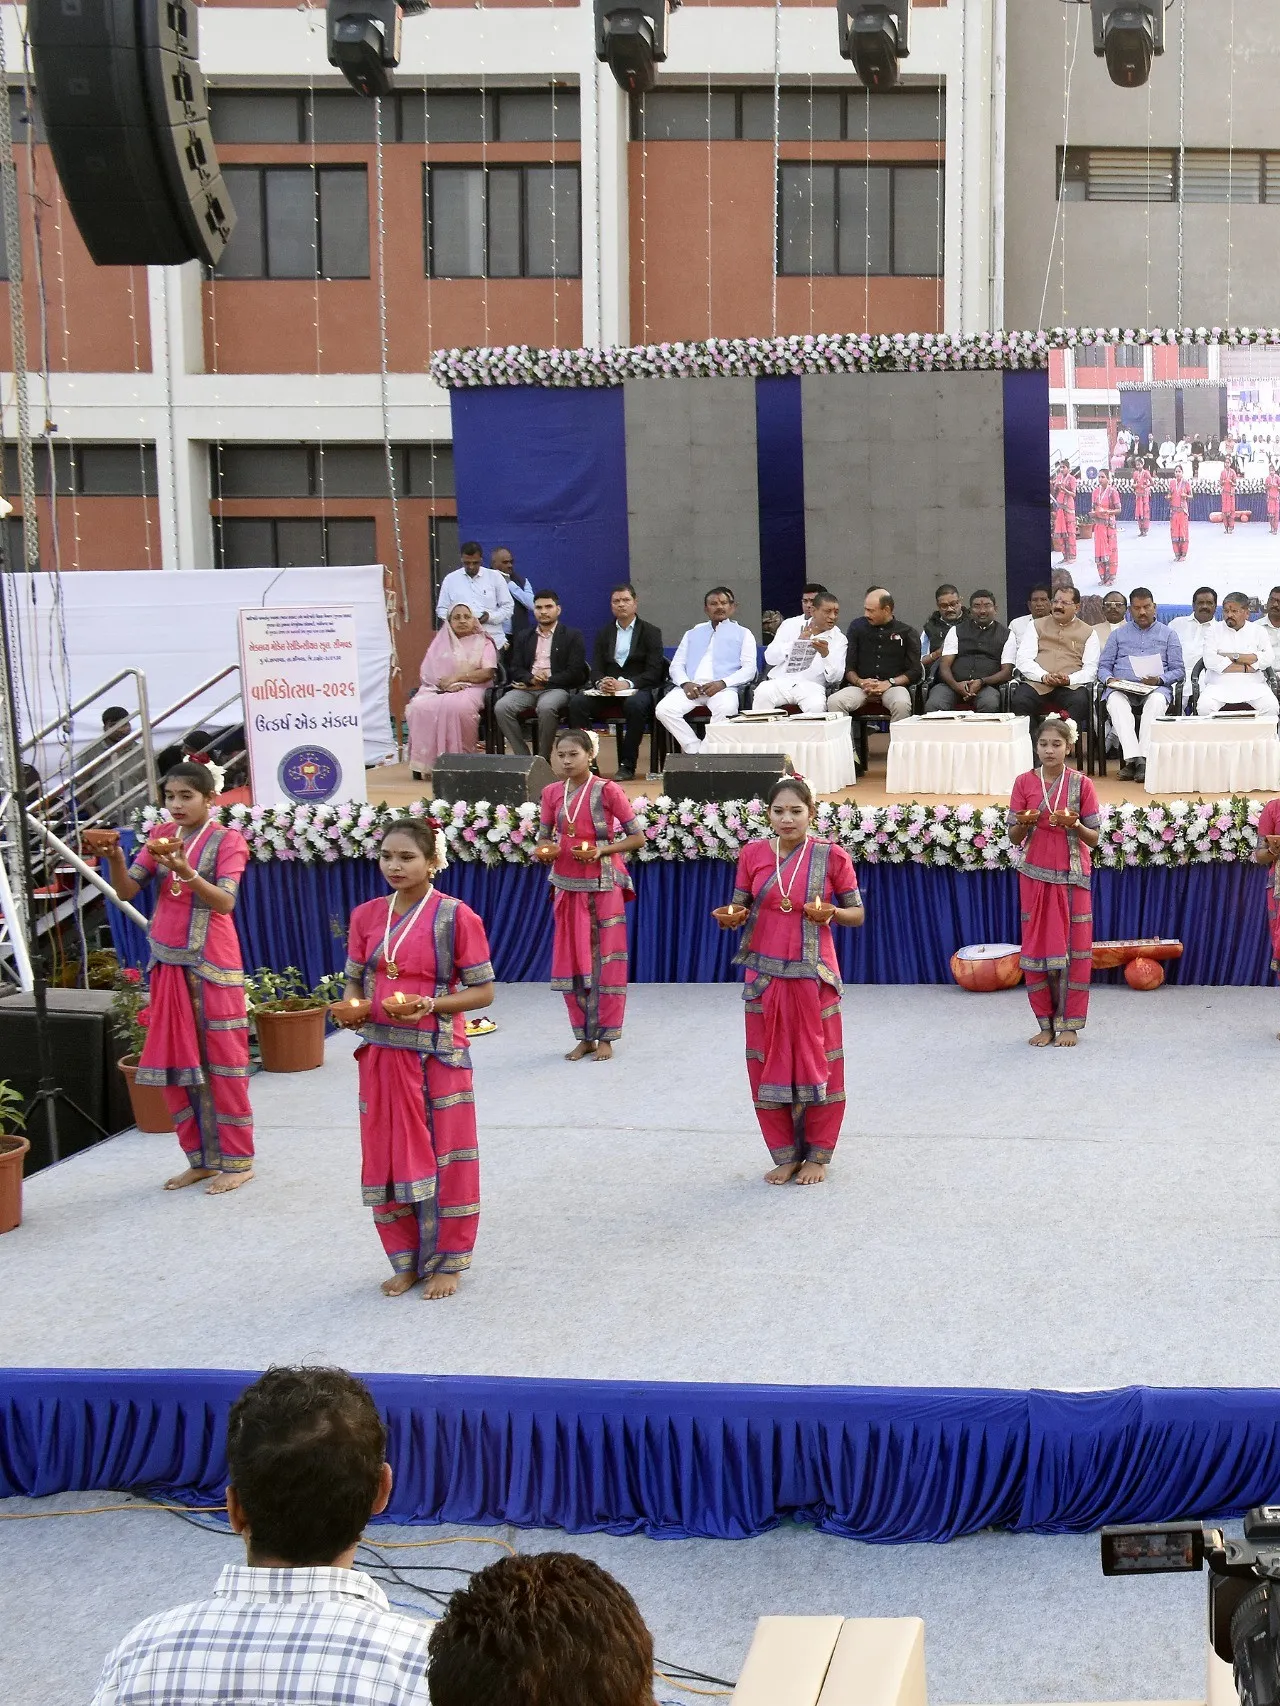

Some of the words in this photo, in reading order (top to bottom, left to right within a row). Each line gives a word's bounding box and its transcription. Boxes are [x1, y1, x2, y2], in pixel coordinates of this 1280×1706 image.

[251, 678, 355, 700] વાર્ષિકોત્સવ-૨૦૨૬
[255, 713, 292, 732] ઉત્કર્ષ
[294, 713, 318, 730] એક
[321, 710, 358, 728] સંકલ્પ
